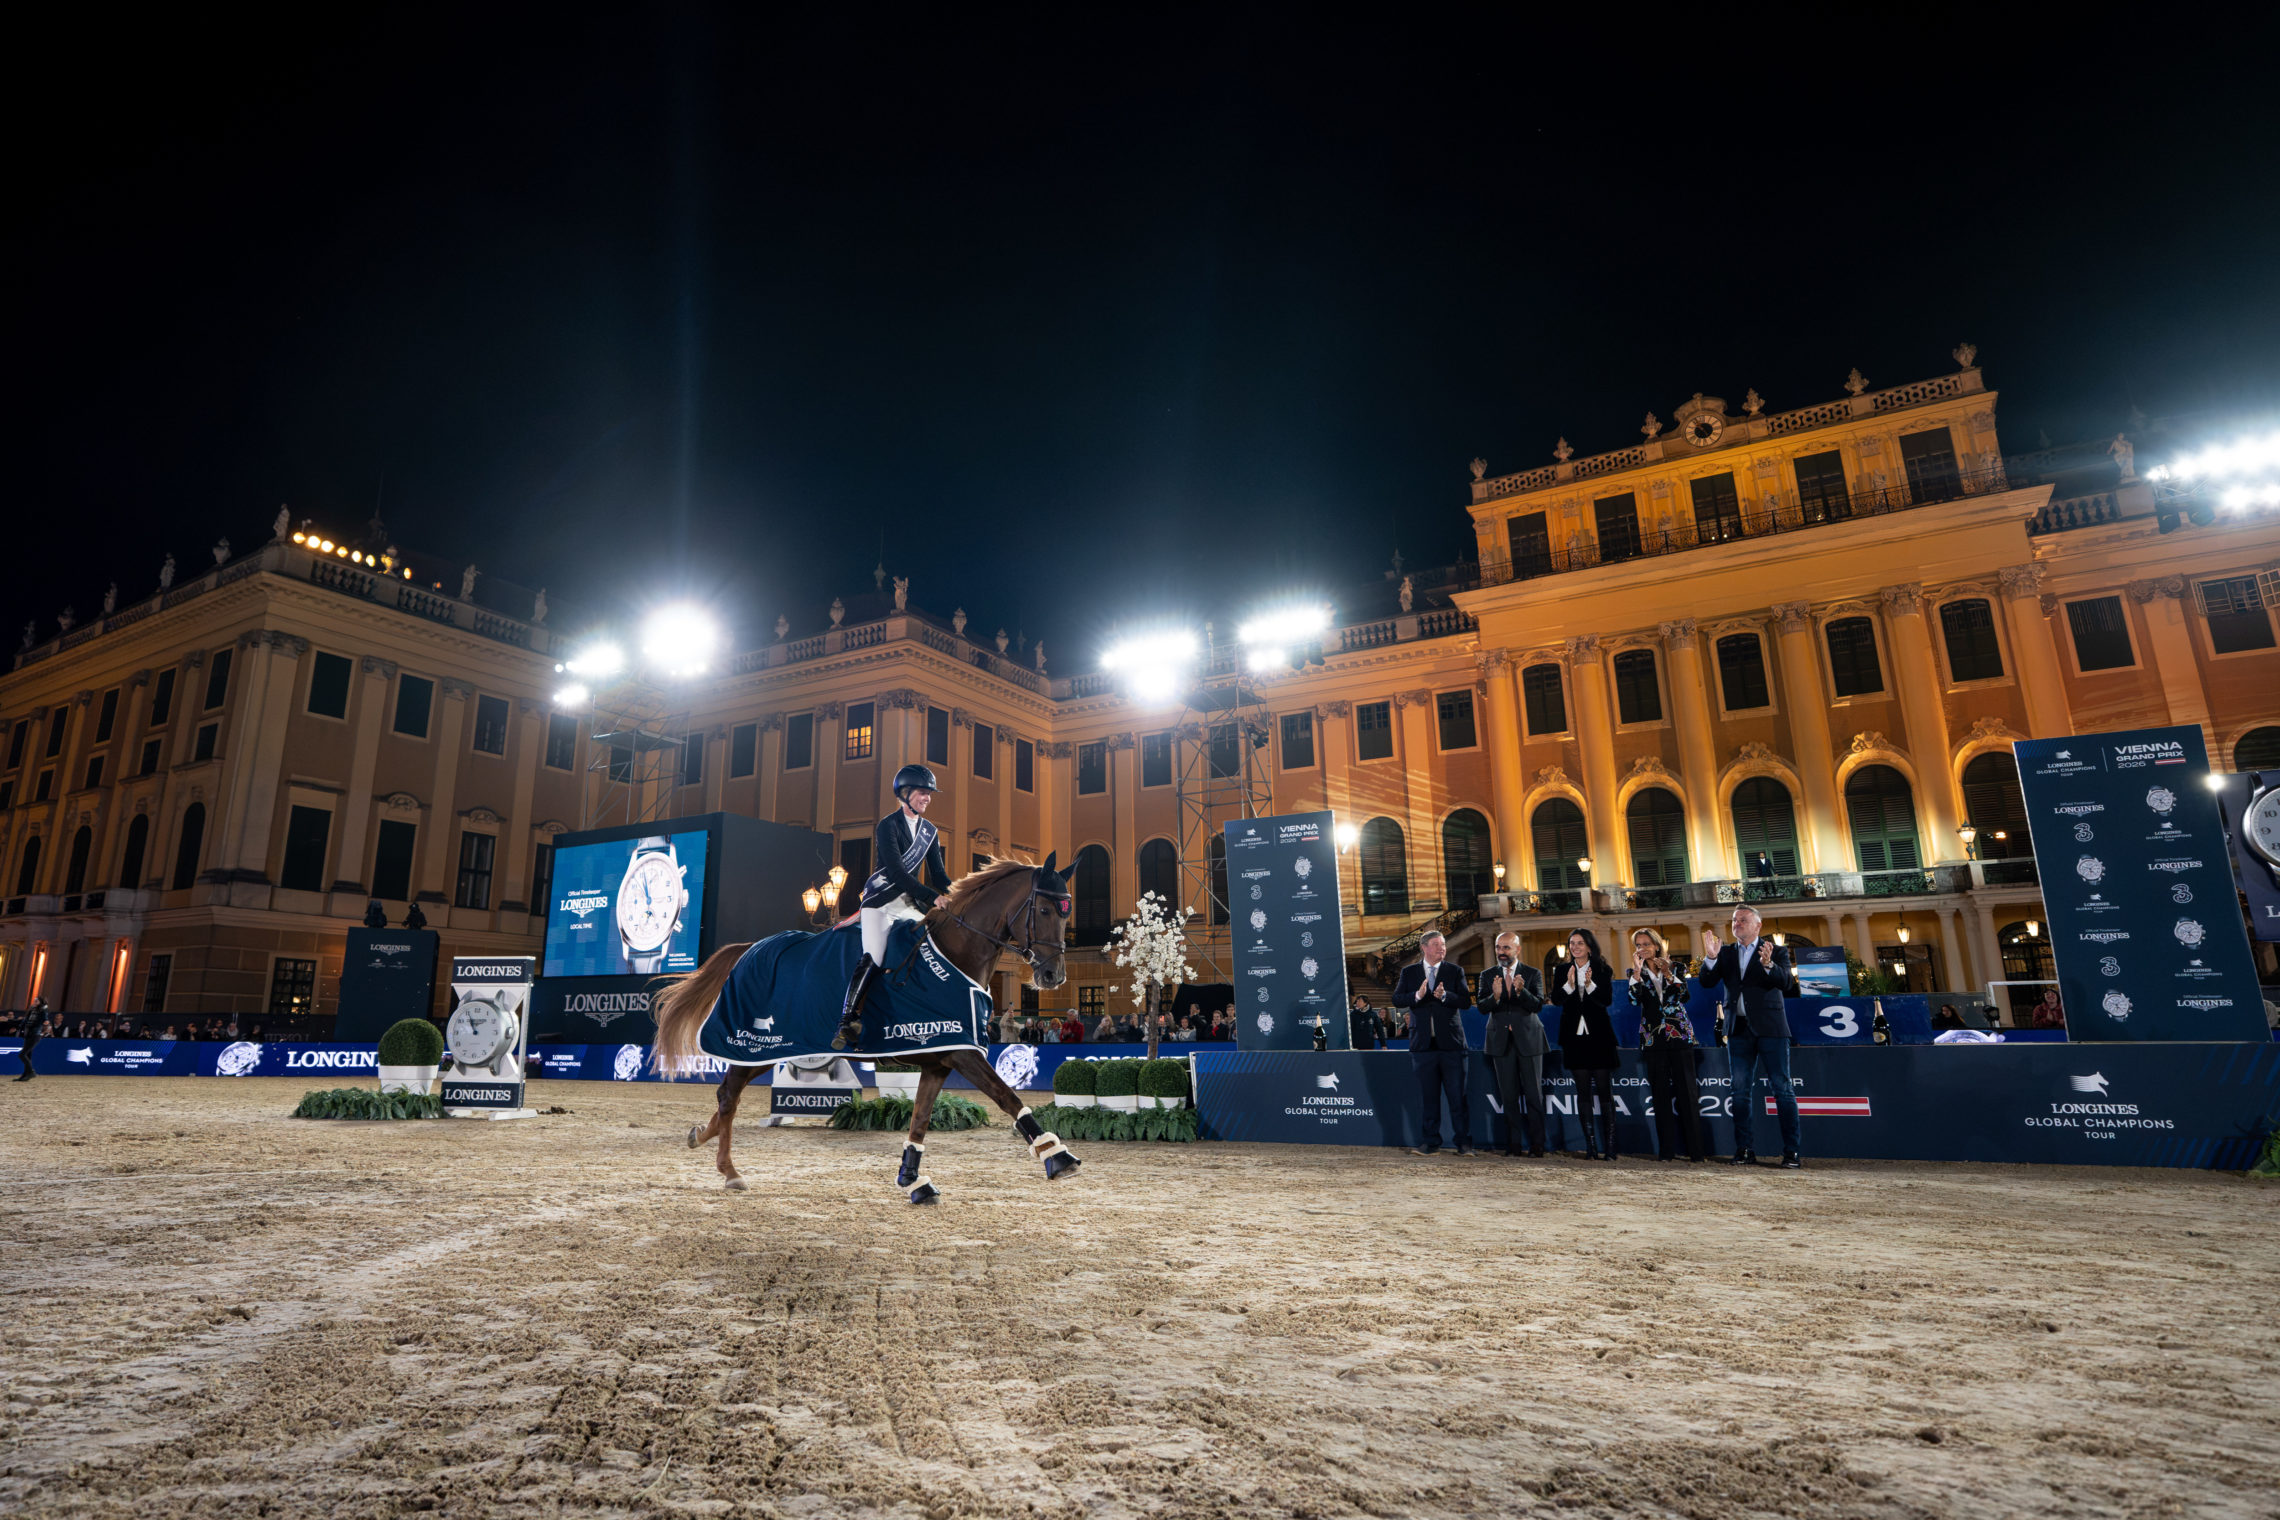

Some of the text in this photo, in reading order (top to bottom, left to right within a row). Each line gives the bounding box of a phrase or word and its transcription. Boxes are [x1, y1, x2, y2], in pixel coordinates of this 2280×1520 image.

[2114, 741, 2183, 755] VIENNA
[2116, 750, 2184, 762] GRAND PRIX
[2117, 761, 2146, 769] 2026
[2054, 804, 2105, 814] LONGINES
[2264, 810, 2278, 818] 10
[1280, 823, 1319, 833] VIENNA
[2073, 822, 2093, 842] 3
[2260, 826, 2271, 836] 9
[2147, 860, 2203, 870] LONGINES
[2171, 883, 2193, 904] 3
[560, 896, 608, 911] LONGINES
[1301, 931, 1314, 947] 3
[2079, 932, 2130, 941] LONGINES
[369, 943, 412, 952] LONGINES
[457, 965, 522, 977] LONGINES
[2099, 956, 2121, 977] 3
[1257, 986, 1270, 1003] 3
[564, 993, 650, 1012] LONGINES
[2176, 999, 2234, 1007] LONGINES
[1818, 1005, 1860, 1038] 3
[883, 1020, 963, 1039] LONGINES
[736, 1029, 783, 1043] LONGINES
[286, 1051, 380, 1067] LONGIN
[659, 1055, 729, 1072] LNGIN
[1612, 1077, 1650, 1087] LOBA
[444, 1088, 512, 1101] LONGINES
[776, 1094, 852, 1107] LONGINES
[1302, 1096, 1355, 1106] LONGINES
[1284, 1107, 1374, 1116] GLOBAL CHAMPIONS
[2050, 1103, 2139, 1115] LONGINES
[2024, 1117, 2175, 1129] GLOBAL CHAMPIONS
[2084, 1131, 2116, 1139] TOUR
